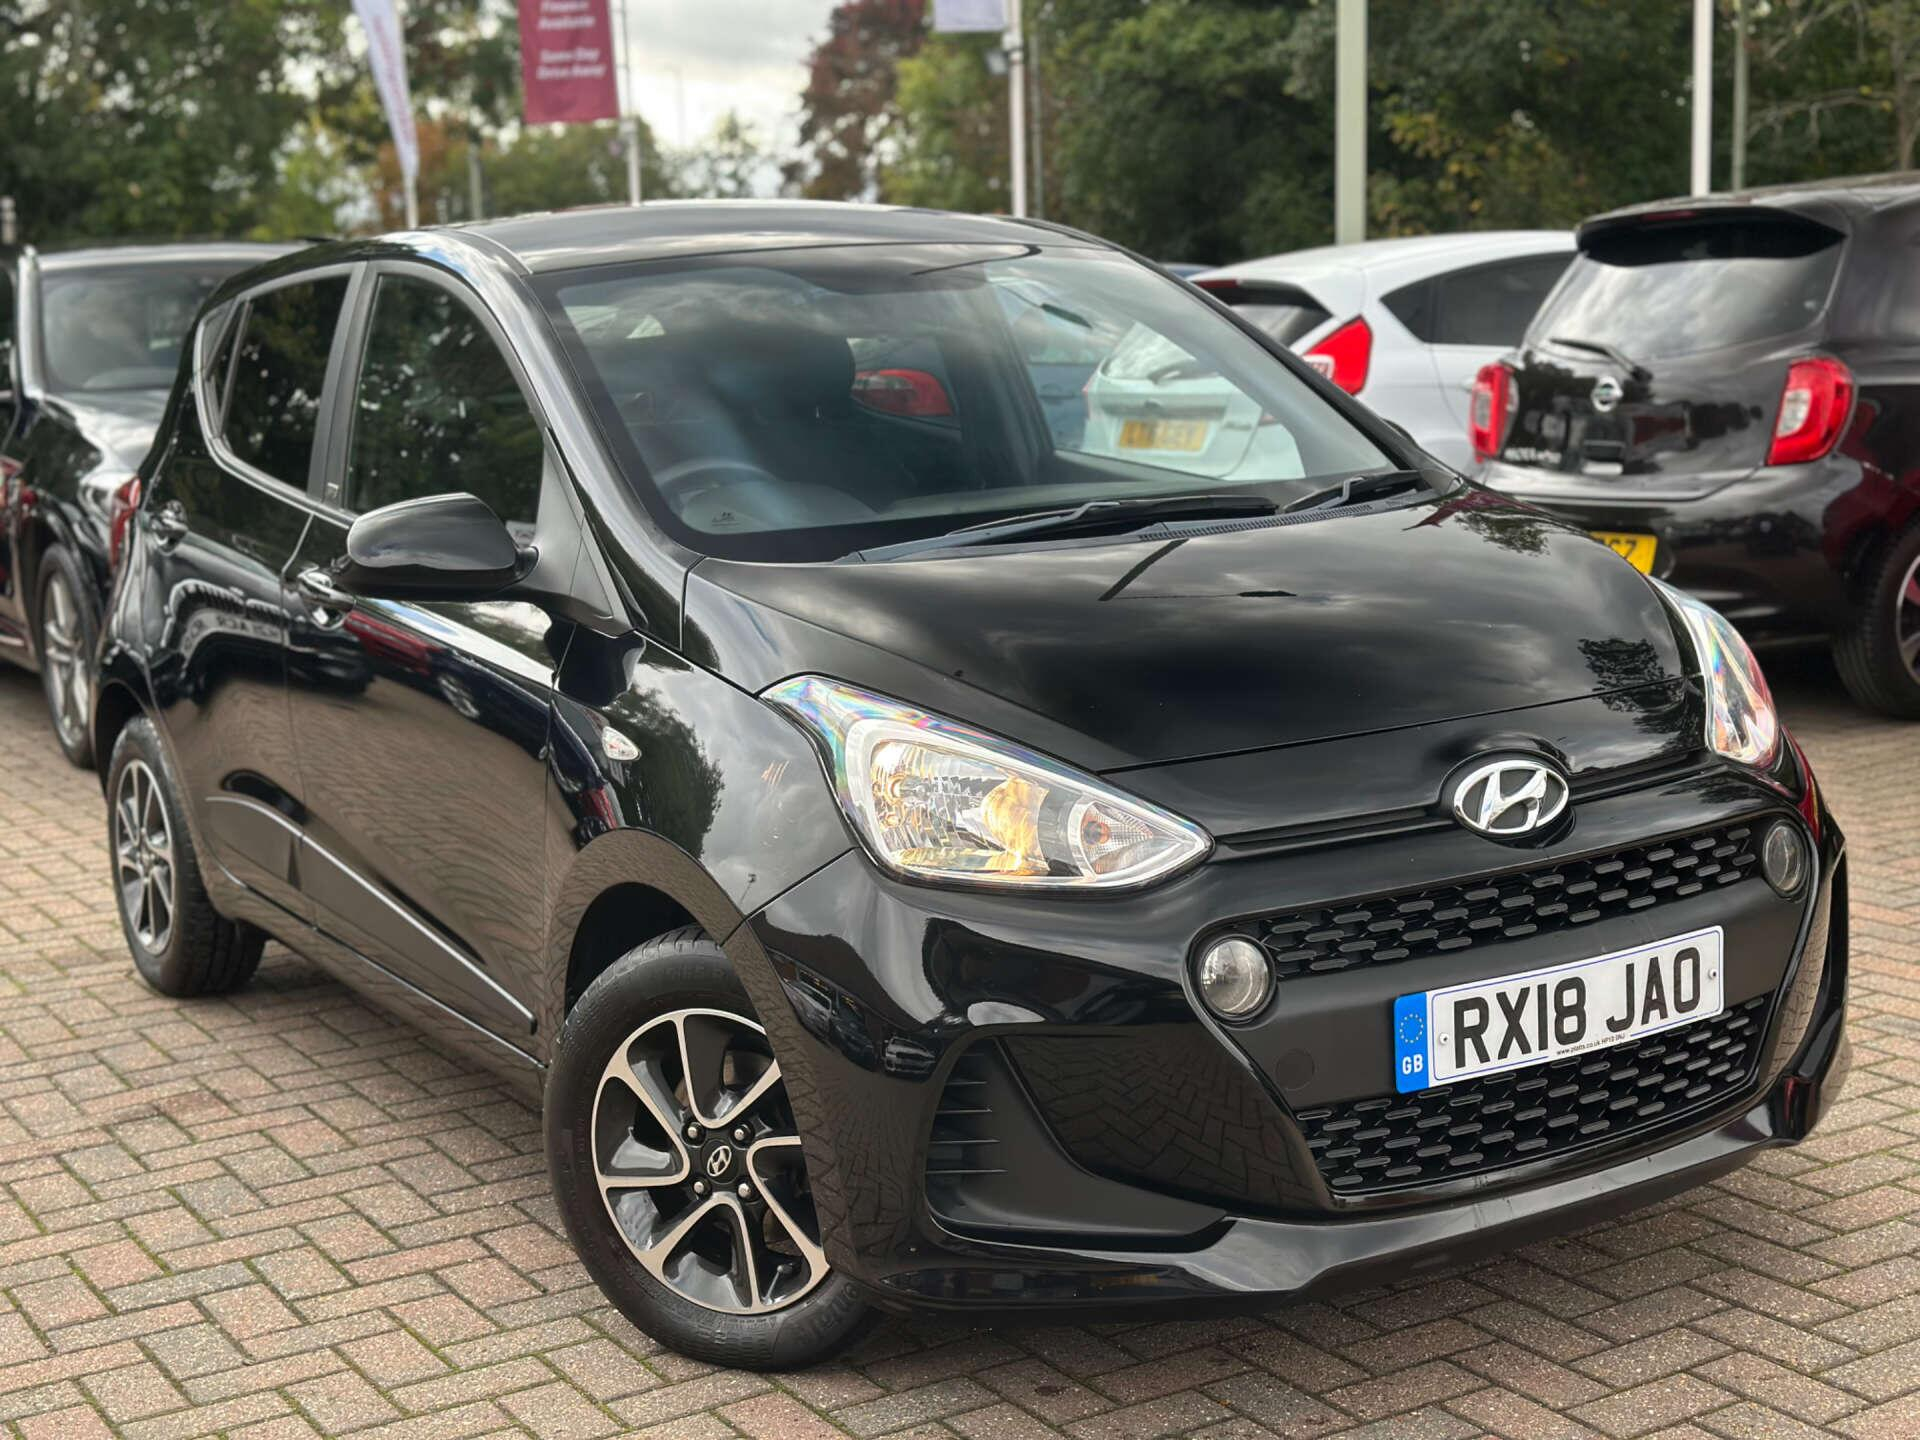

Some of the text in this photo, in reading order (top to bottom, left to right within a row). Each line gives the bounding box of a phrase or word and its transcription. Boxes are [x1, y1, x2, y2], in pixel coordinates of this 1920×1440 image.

[1454, 946, 1701, 1069] RX18 JAO
[1402, 1054, 1423, 1075] GB
